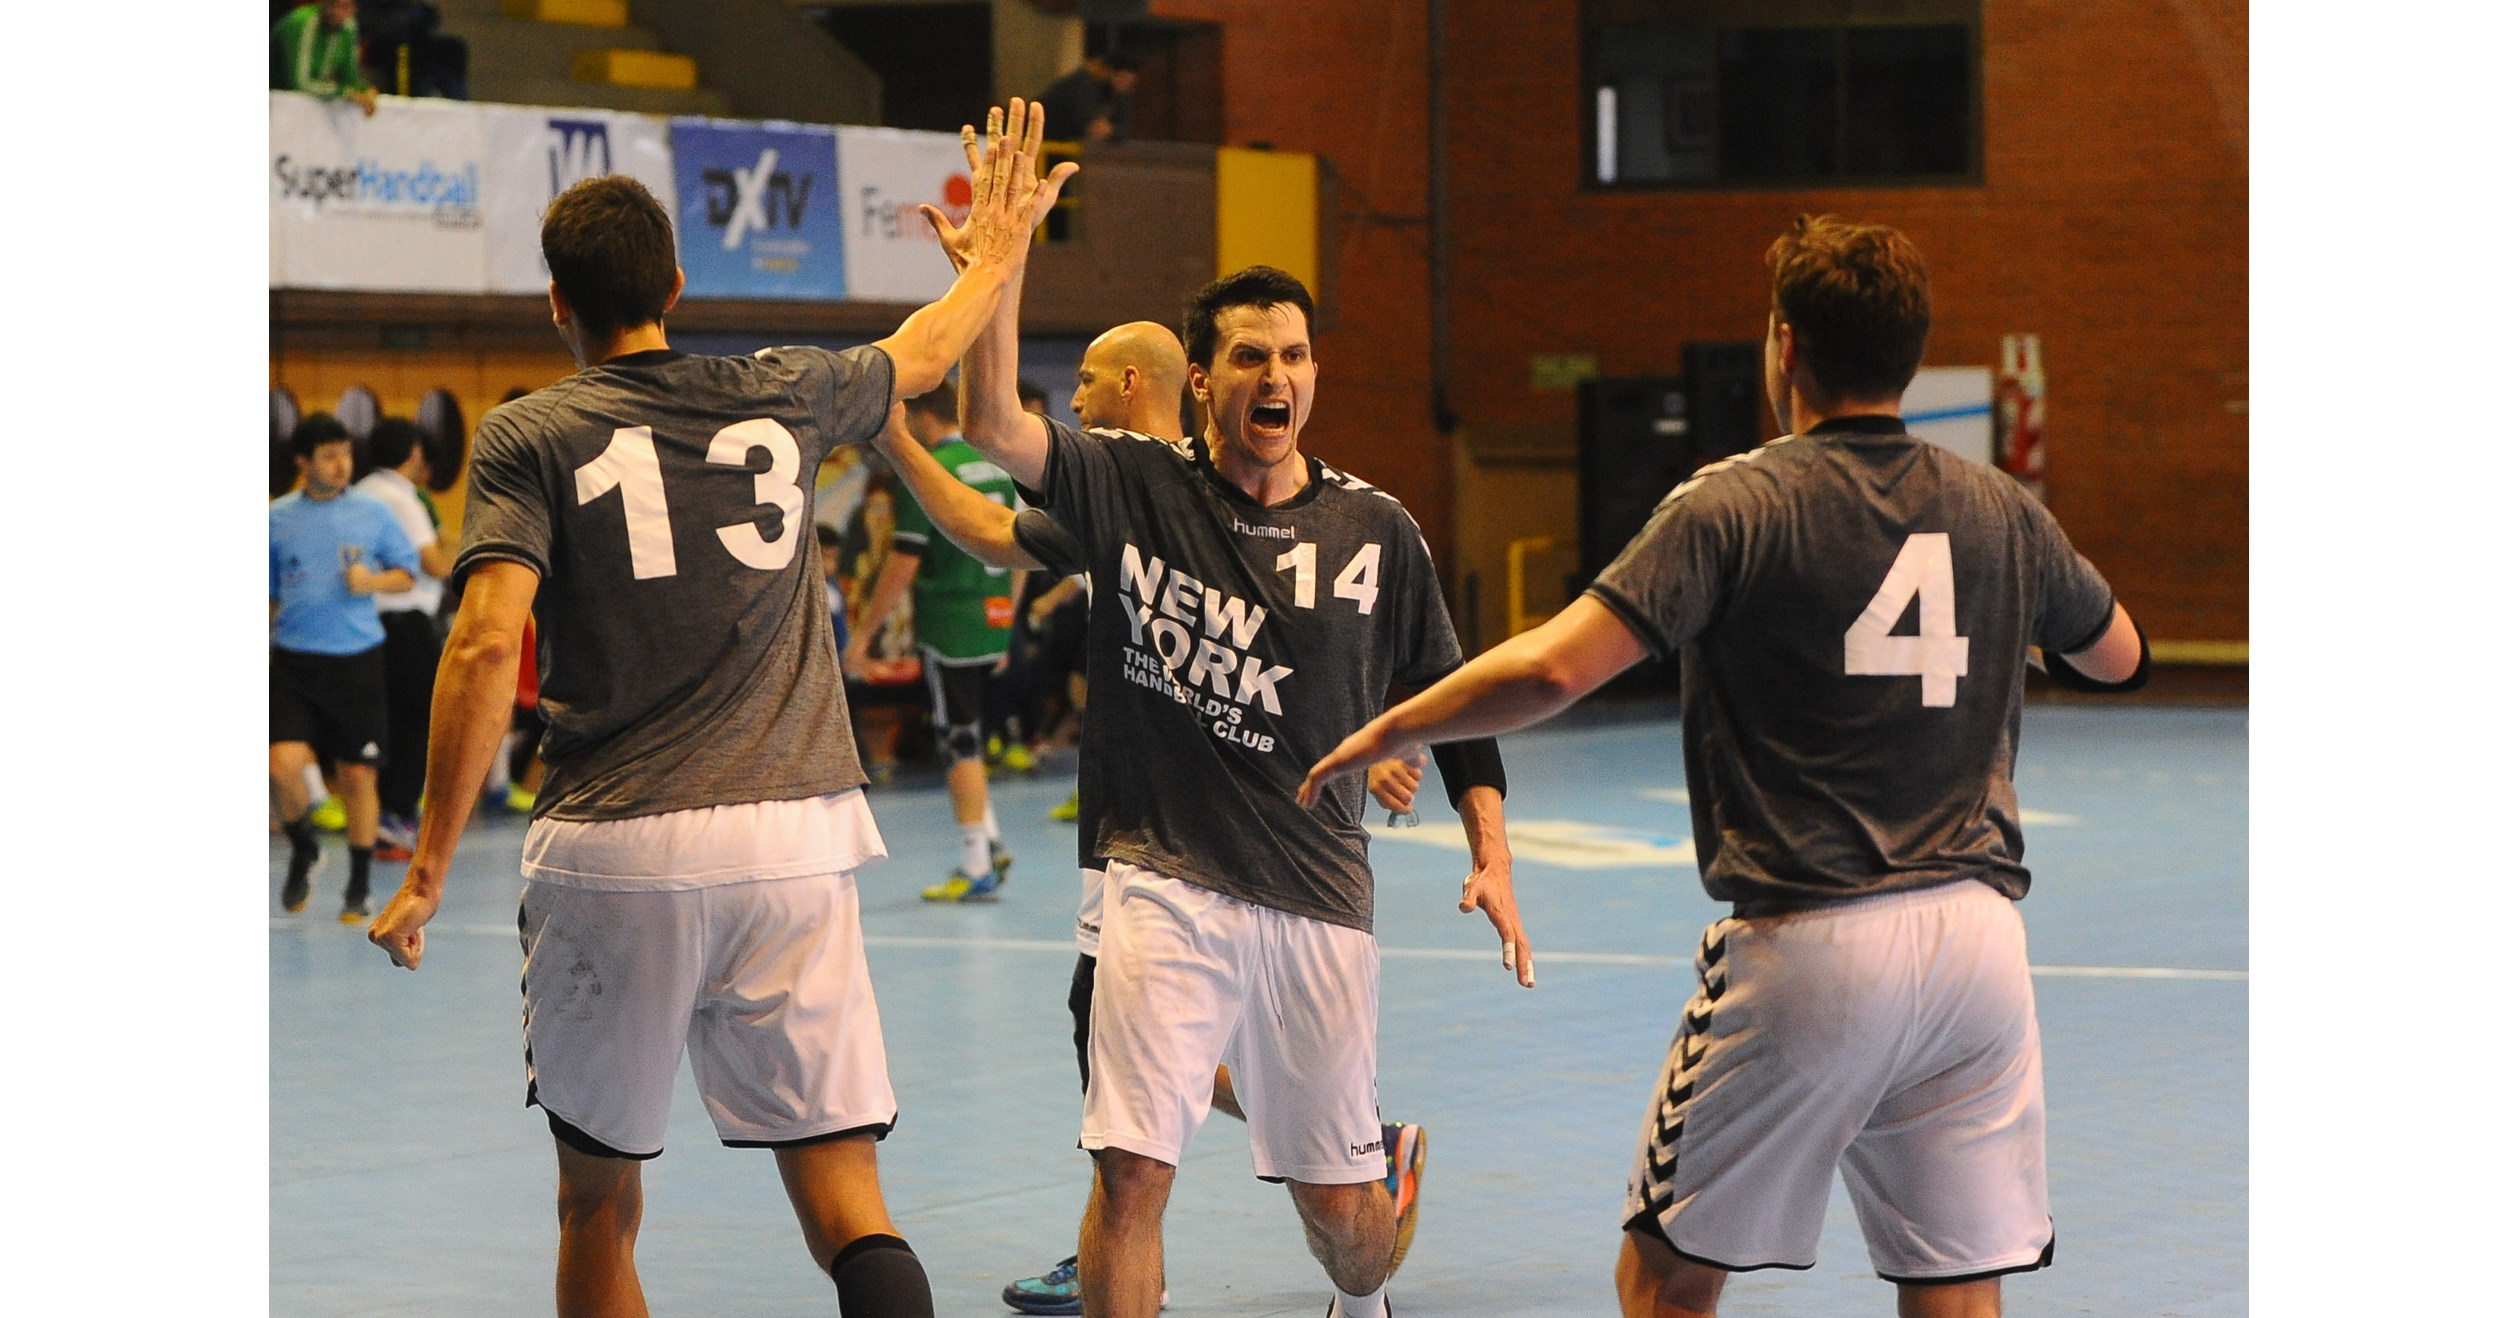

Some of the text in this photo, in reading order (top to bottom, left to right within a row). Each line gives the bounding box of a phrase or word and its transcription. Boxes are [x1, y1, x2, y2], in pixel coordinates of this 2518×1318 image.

[574, 417, 805, 580] 13
[1233, 517, 1296, 540] hummel
[1120, 542, 1269, 651] NEW
[1276, 541, 1382, 616] 14
[1844, 532, 1970, 708] 4
[1118, 592, 1295, 717] YORK
[1123, 646, 1160, 675] THE
[1212, 719, 1275, 753] CLUB
